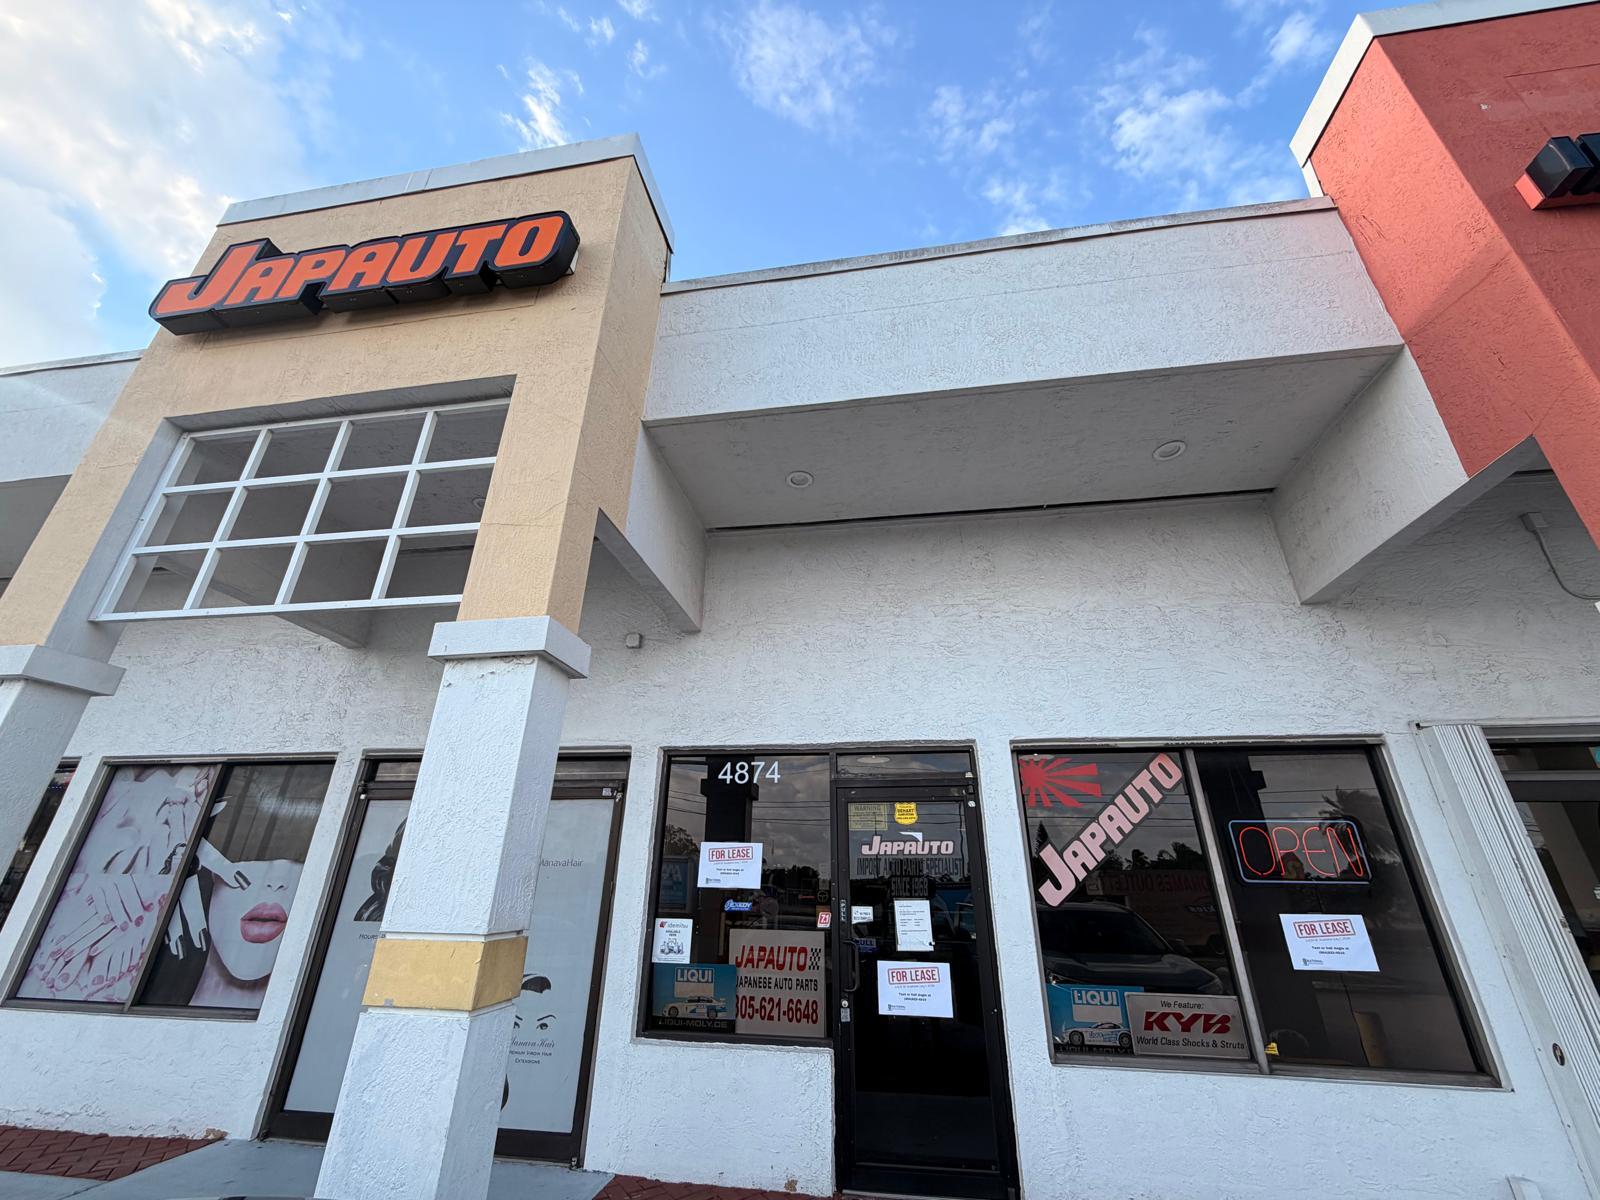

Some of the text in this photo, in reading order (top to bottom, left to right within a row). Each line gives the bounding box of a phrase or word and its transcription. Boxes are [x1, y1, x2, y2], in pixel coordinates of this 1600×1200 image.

[153, 214, 566, 315] JAPAUTO
[717, 760, 781, 785] 4874
[1037, 752, 1183, 907] JAPAUTO
[861, 835, 954, 855] JAPAUTO
[1238, 826, 1364, 877] OPEN
[711, 848, 751, 860] FOR LEASE
[891, 877, 910, 897] SINCE
[667, 921, 689, 929] idemitsu
[1297, 921, 1351, 936] FOR LEASE
[735, 945, 808, 972] JAPAUTO
[677, 968, 713, 983] LIQUI
[890, 969, 937, 982] FOR LEASE
[774, 977, 793, 991] AUTO
[795, 978, 818, 992] PARTS
[1073, 989, 1118, 1006] LIQUI
[1160, 1000, 1205, 1010] We Feature:
[1143, 1011, 1232, 1035] KYB
[1136, 1036, 1245, 1050] World Class Shocks & Struts
